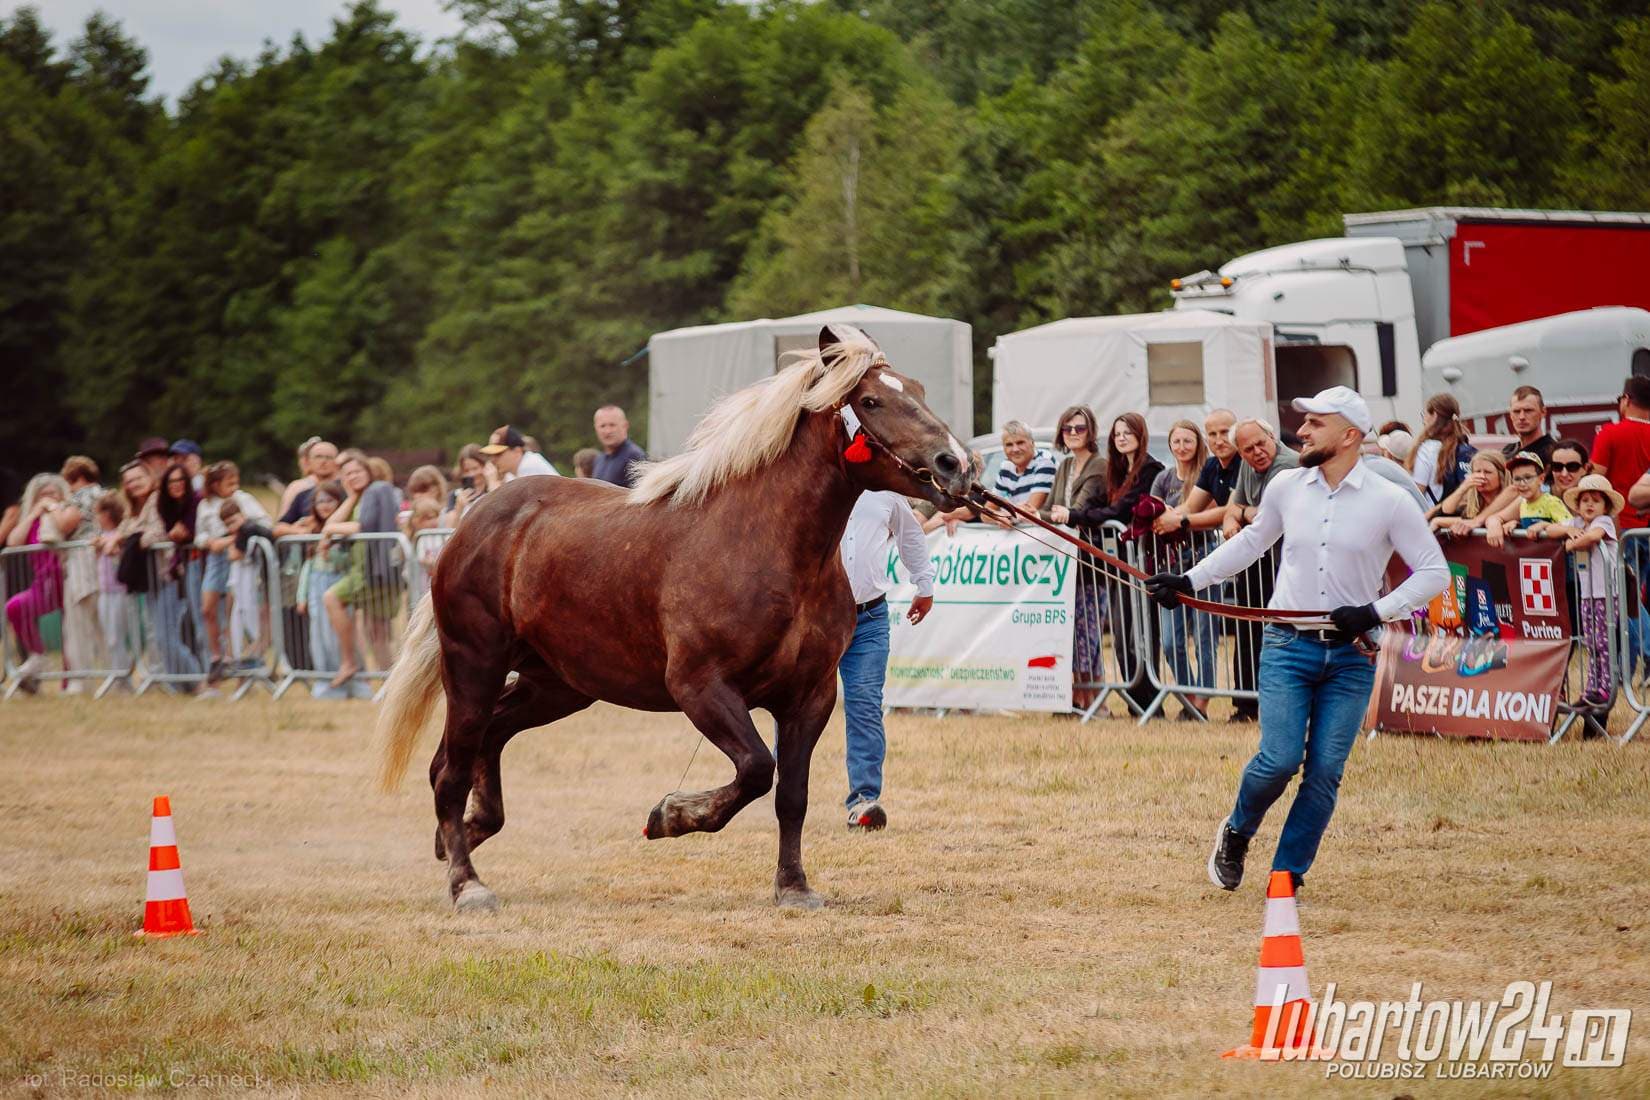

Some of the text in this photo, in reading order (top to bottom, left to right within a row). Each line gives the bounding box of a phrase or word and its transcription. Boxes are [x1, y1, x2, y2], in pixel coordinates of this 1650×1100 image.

[931, 544, 1070, 597] ółdzielczy
[1012, 608, 1066, 627] Grupa BPS
[1523, 620, 1562, 640] Purina
[1391, 684, 1552, 724] PASZE DLA KONI
